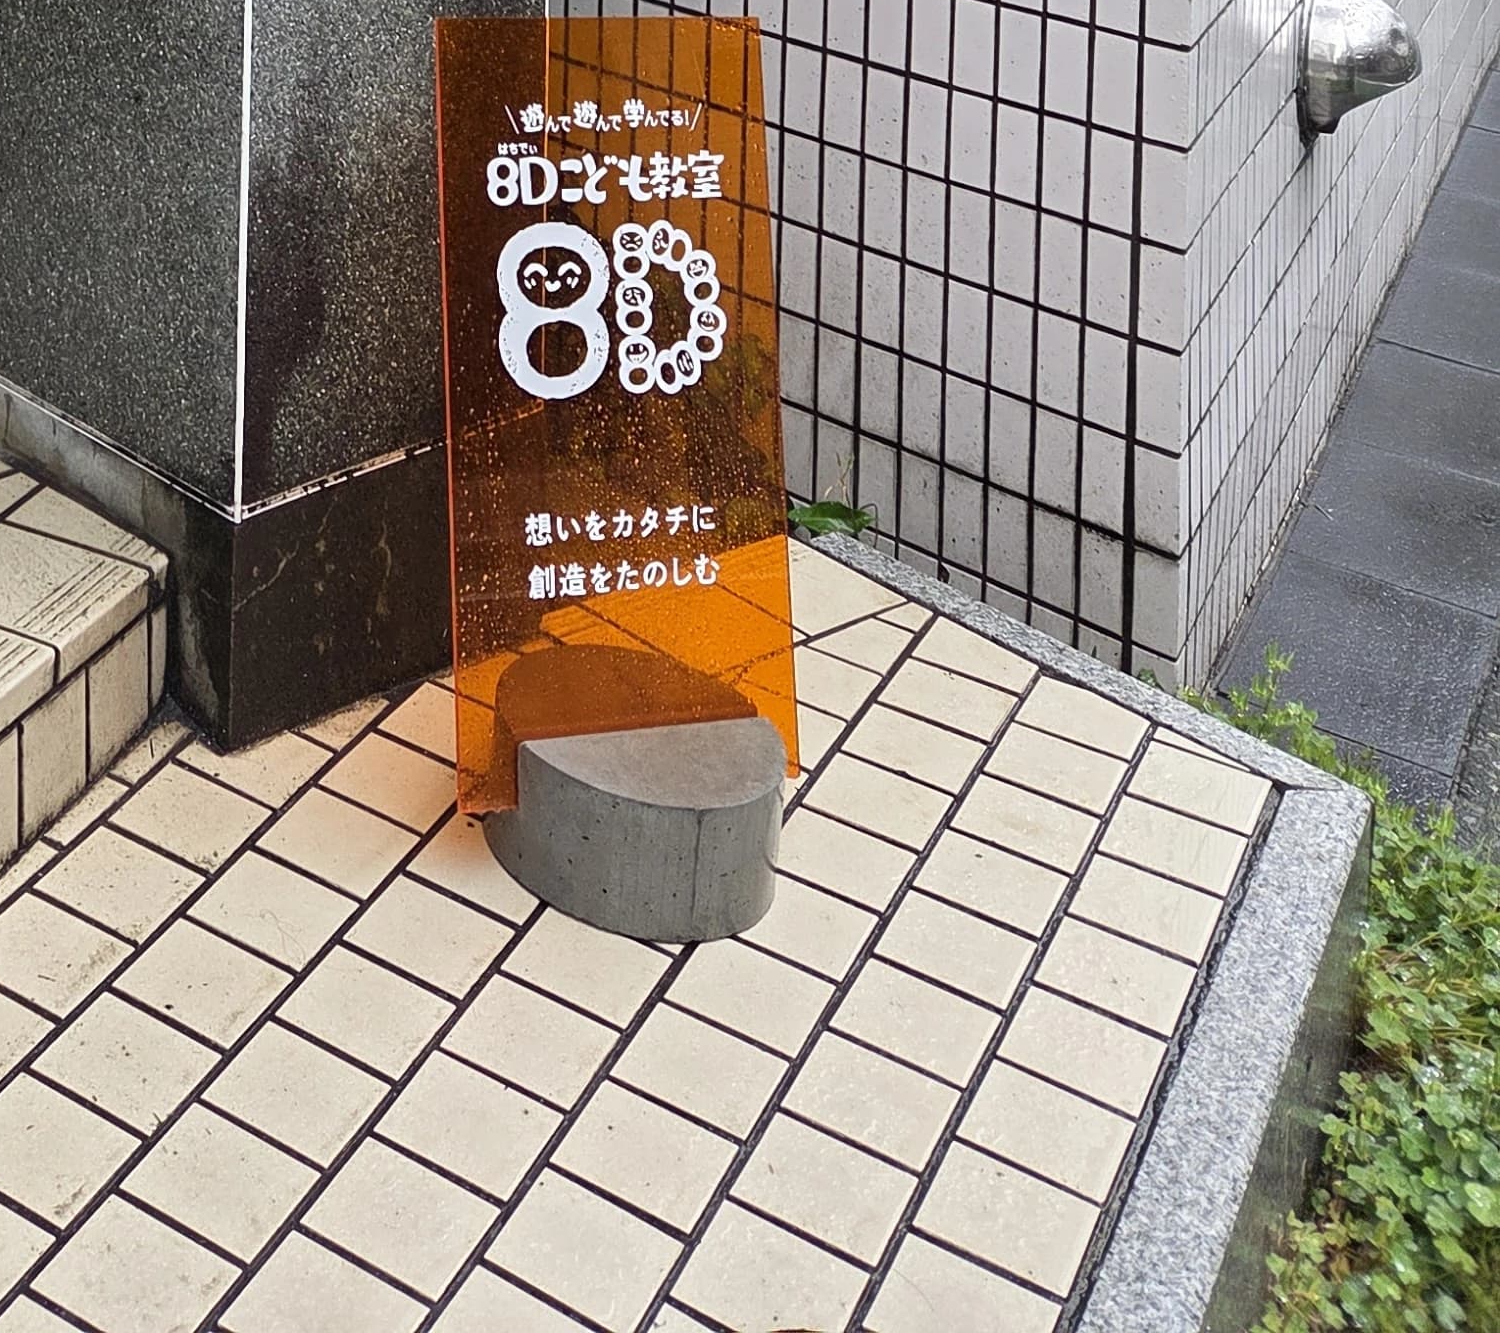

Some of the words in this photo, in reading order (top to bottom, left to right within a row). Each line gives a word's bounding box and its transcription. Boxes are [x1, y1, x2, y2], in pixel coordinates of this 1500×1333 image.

[486, 150, 725, 207] 8Dこども教室
[524, 504, 717, 547] 想いをカタチに
[527, 552, 721, 600] 創造をたのしむ
